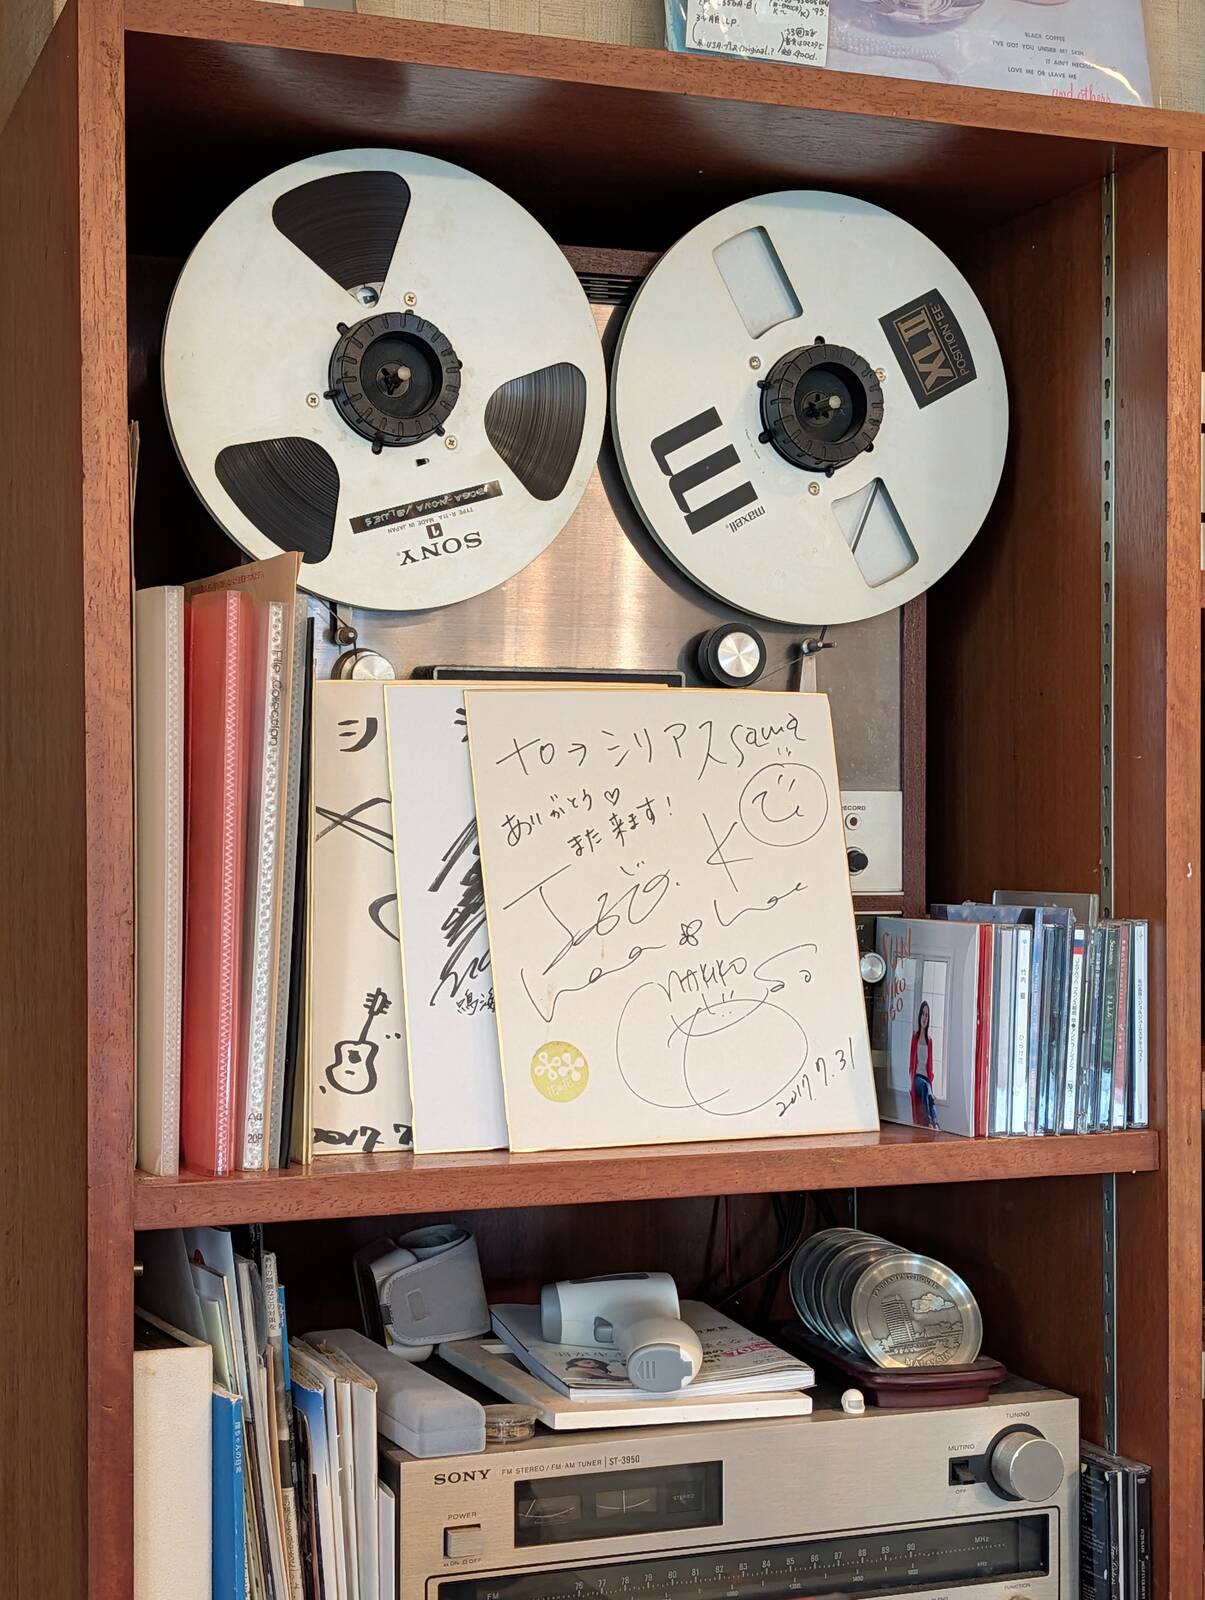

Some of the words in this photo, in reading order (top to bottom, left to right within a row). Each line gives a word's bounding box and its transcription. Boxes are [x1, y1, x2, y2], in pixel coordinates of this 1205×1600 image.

[1024, 31, 1042, 39] BLACK
[1007, 66, 1023, 74] LOVE
[417, 516, 435, 527] MADE
[729, 506, 766, 533] maxell
[387, 524, 407, 534] JAPAN
[400, 531, 483, 566] SONY
[270, 679, 281, 746] Collection
[501, 788, 594, 847] ありがとう
[247, 1113, 263, 1122] A4
[1005, 1410, 1031, 1419] TUNING
[947, 1443, 976, 1452] MUTING
[434, 1468, 492, 1485] SONY
[501, 1468, 513, 1476] FM
[577, 1459, 602, 1468] TUNER
[608, 1454, 641, 1466] ST-3950
[447, 1511, 477, 1520] POWER
[486, 1592, 500, 1600] FM
[597, 1579, 607, 1587] 77
[621, 1577, 630, 1585] 78
[644, 1574, 653, 1582] 79
[691, 1568, 700, 1576] 81
[715, 1565, 724, 1573] 82
[738, 1562, 748, 1571] 83
[761, 1559, 771, 1568] 84
[786, 1557, 795, 1565] 85
[810, 1554, 819, 1563] 86
[834, 1552, 843, 1560] 87
[857, 1549, 867, 1557] 88
[881, 1546, 890, 1554] 89
[906, 1543, 916, 1551] 90
[974, 1535, 990, 1543] MHz
[1003, 1582, 1031, 1590] FUNCTION
